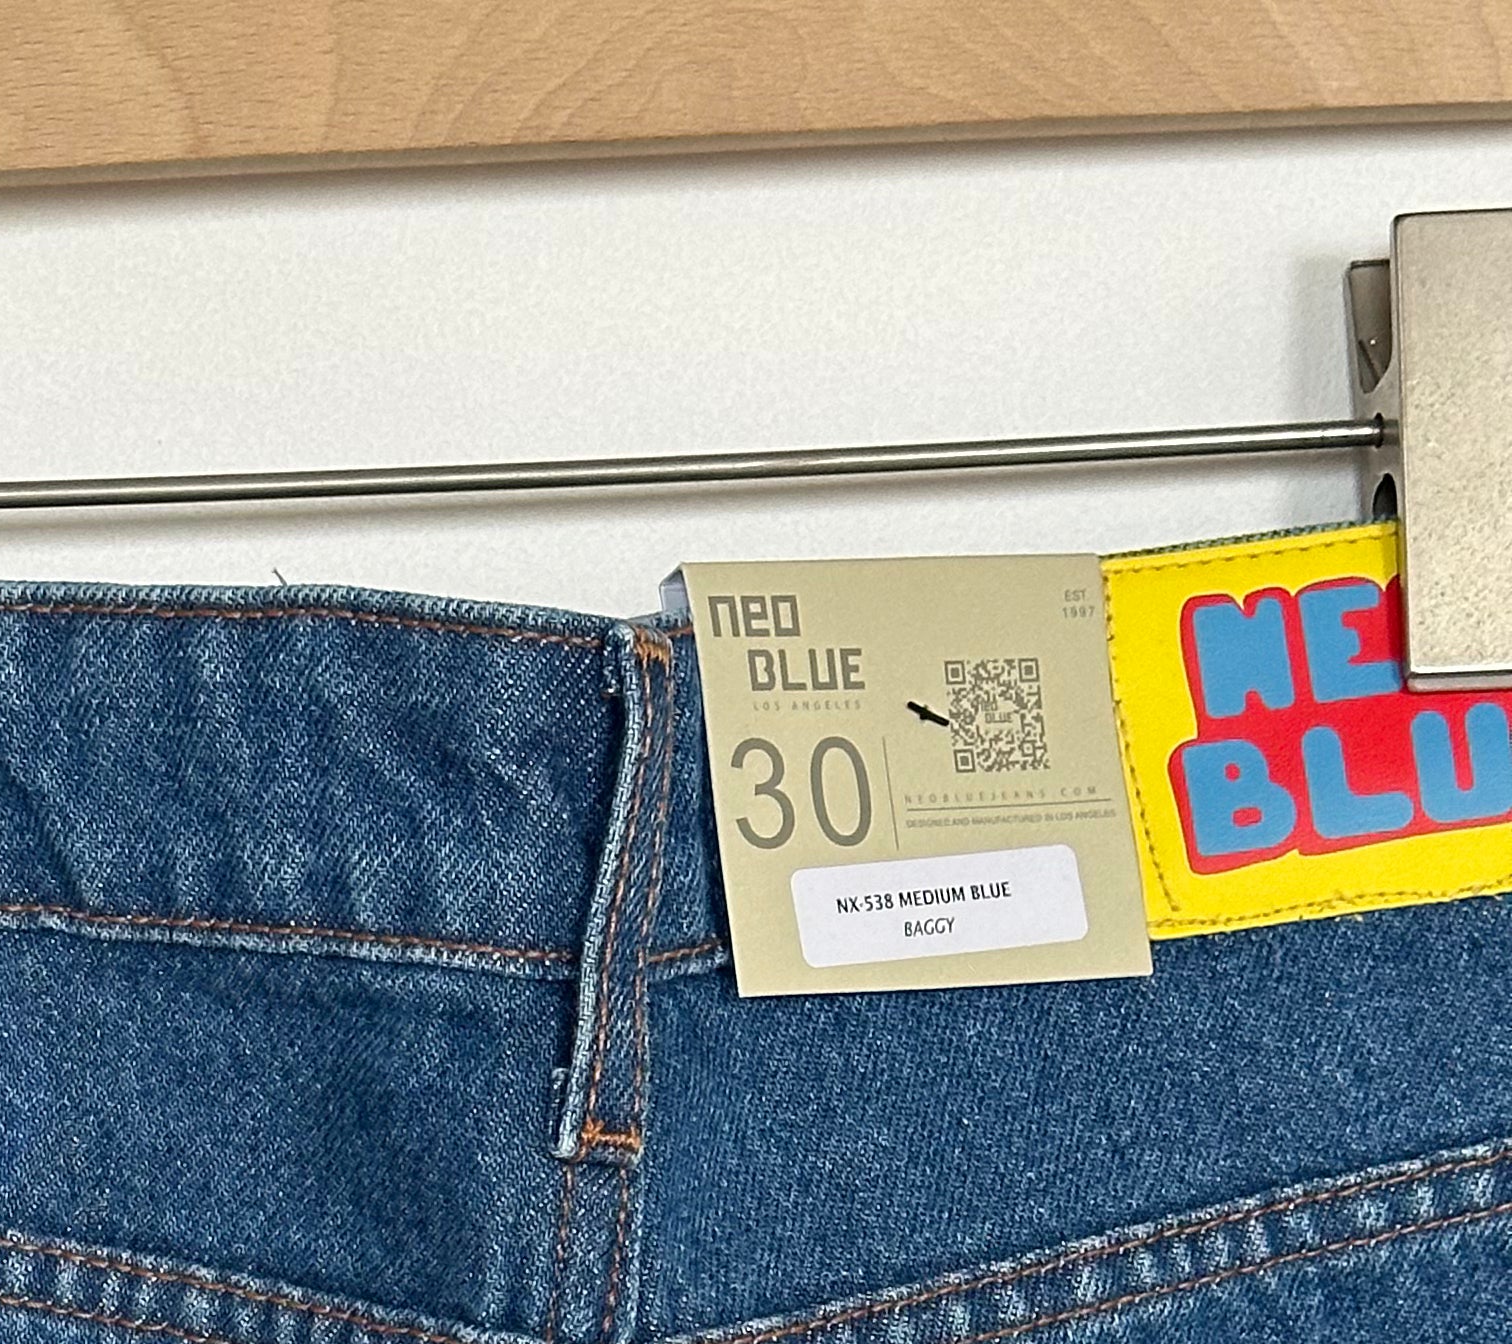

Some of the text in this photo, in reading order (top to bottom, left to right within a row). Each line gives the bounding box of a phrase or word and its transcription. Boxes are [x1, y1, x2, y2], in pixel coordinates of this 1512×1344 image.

[1062, 605, 1095, 619] 1997
[1193, 584, 1403, 719] NE
[748, 648, 866, 691] BLUE
[753, 700, 862, 711] LOS ANGELES
[731, 736, 873, 849] 30
[836, 881, 1013, 914] NX-538 MEDIUM BLUE
[904, 917, 955, 937] BAGGY
